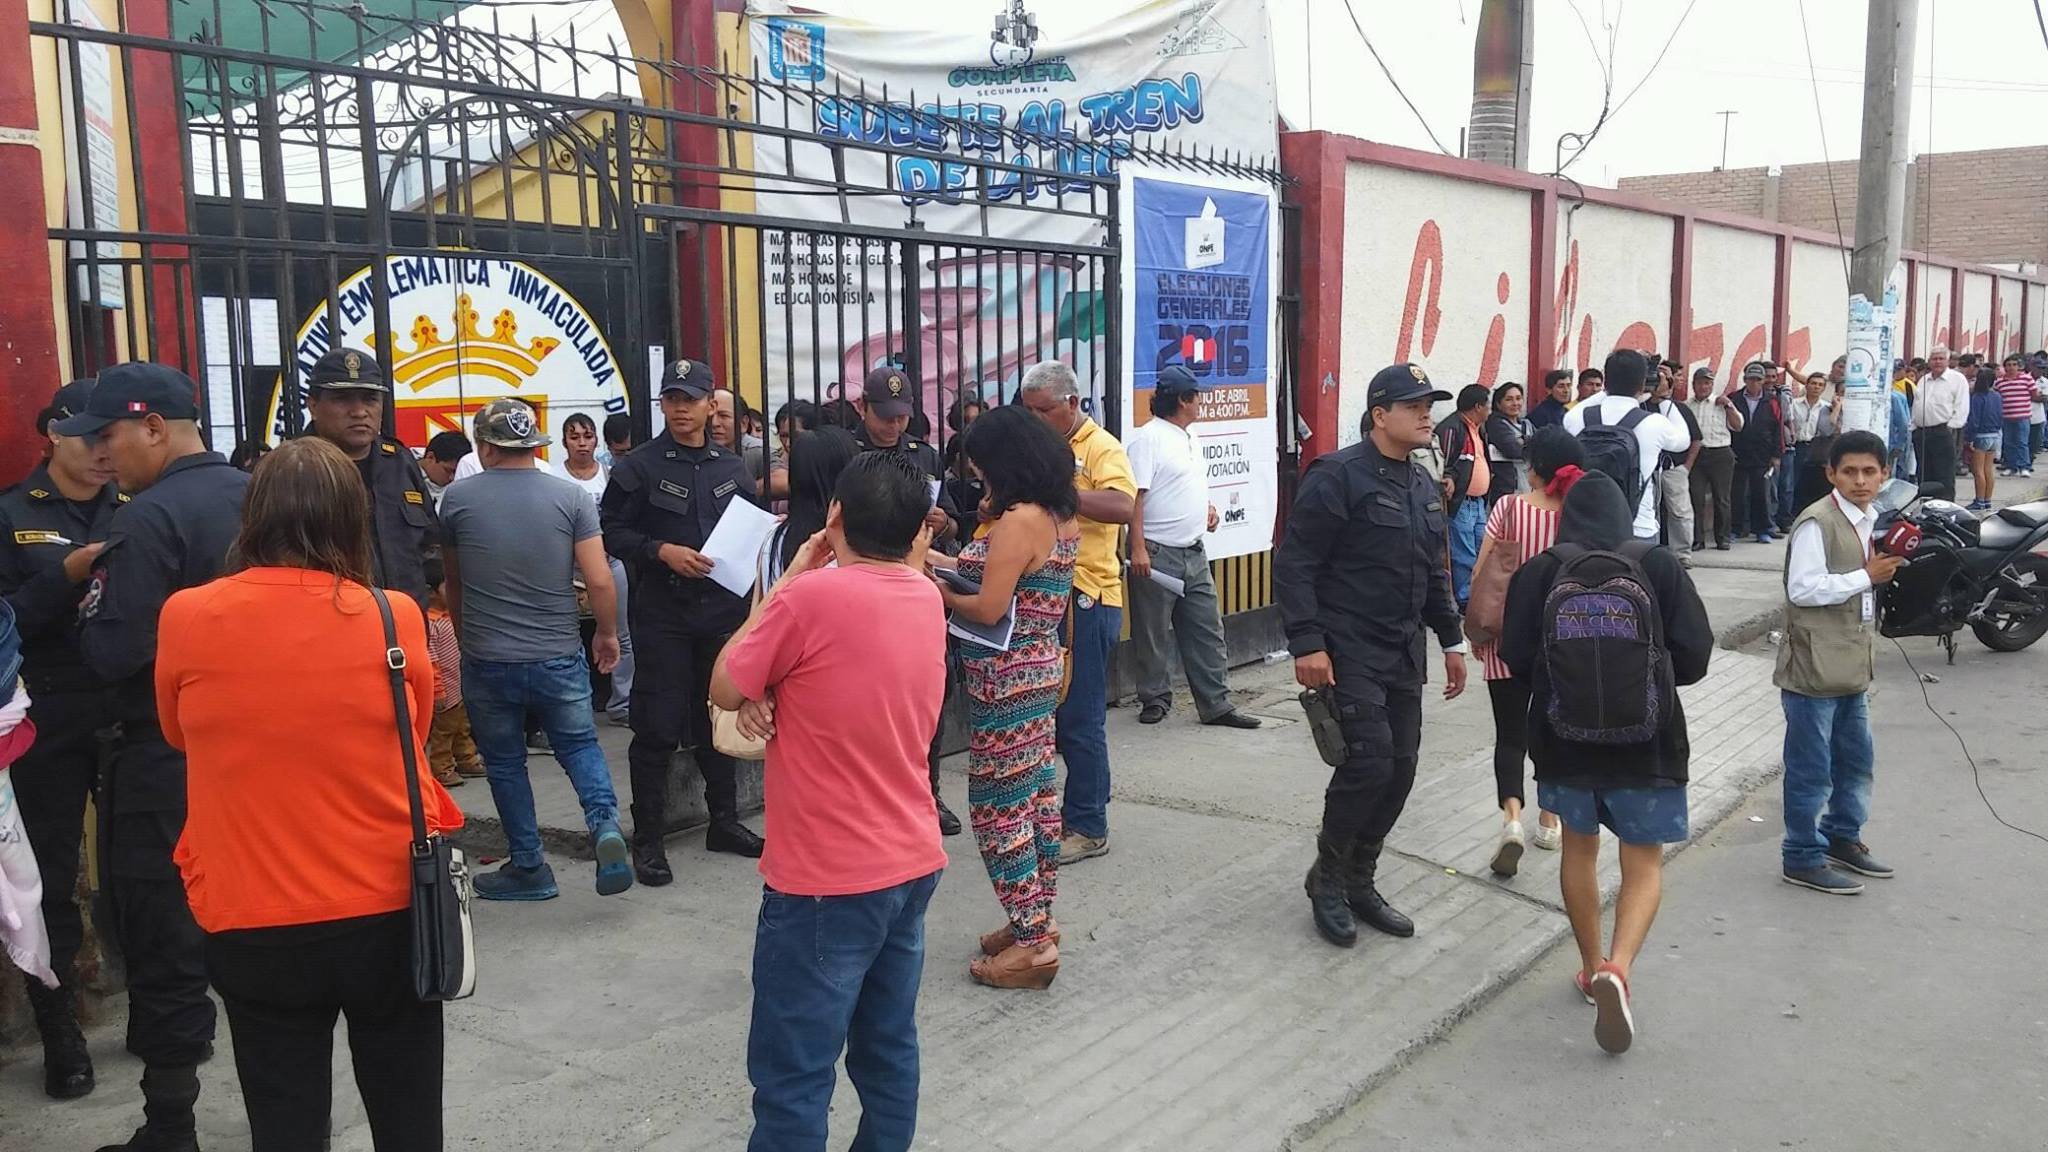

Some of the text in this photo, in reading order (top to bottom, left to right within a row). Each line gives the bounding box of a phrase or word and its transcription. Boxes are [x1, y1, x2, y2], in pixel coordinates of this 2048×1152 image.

[947, 62, 1076, 88] COMPLETA
[976, 85, 1049, 98] SECUNDARIA
[817, 72, 1205, 153] SUBETE AL TREN
[896, 155, 969, 206] DE
[796, 233, 834, 247] HORAS
[855, 236, 893, 248] CASS
[797, 252, 834, 266] HORAS
[798, 272, 835, 286] HORAS
[1157, 273, 1250, 298] ELECCIONES
[774, 288, 875, 305] EDUCAIÓN ÍSIA
[1157, 296, 1252, 321] GENERALES
[1156, 324, 1250, 379] 2016
[1214, 389, 1226, 404] DE
[1227, 388, 1250, 403] ABRIL
[1224, 443, 1231, 457] A
[1231, 443, 1243, 456] TU
[1224, 507, 1245, 523] ONPE
